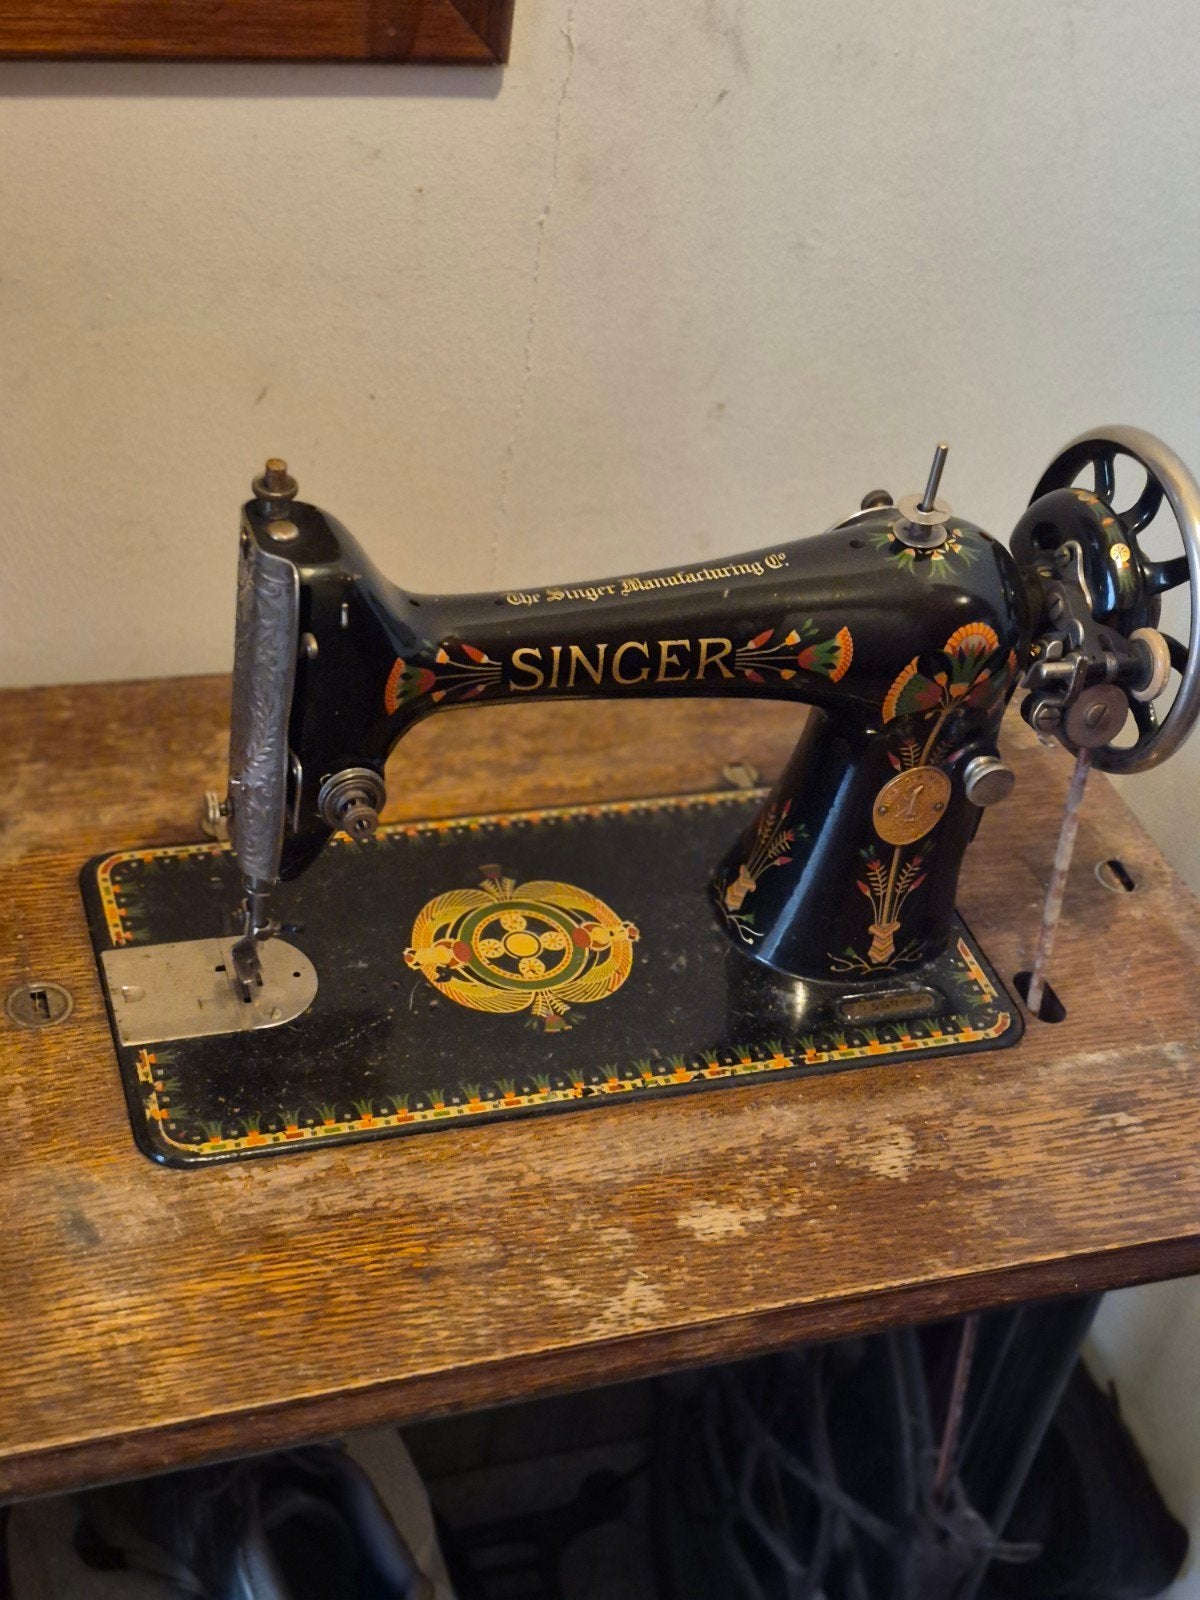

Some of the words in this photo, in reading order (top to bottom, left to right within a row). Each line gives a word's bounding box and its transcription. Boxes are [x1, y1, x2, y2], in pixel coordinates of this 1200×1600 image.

[505, 592, 541, 607] The
[545, 583, 617, 602] Singer
[620, 559, 764, 597] Manufacturing
[509, 637, 737, 692] SINGER
